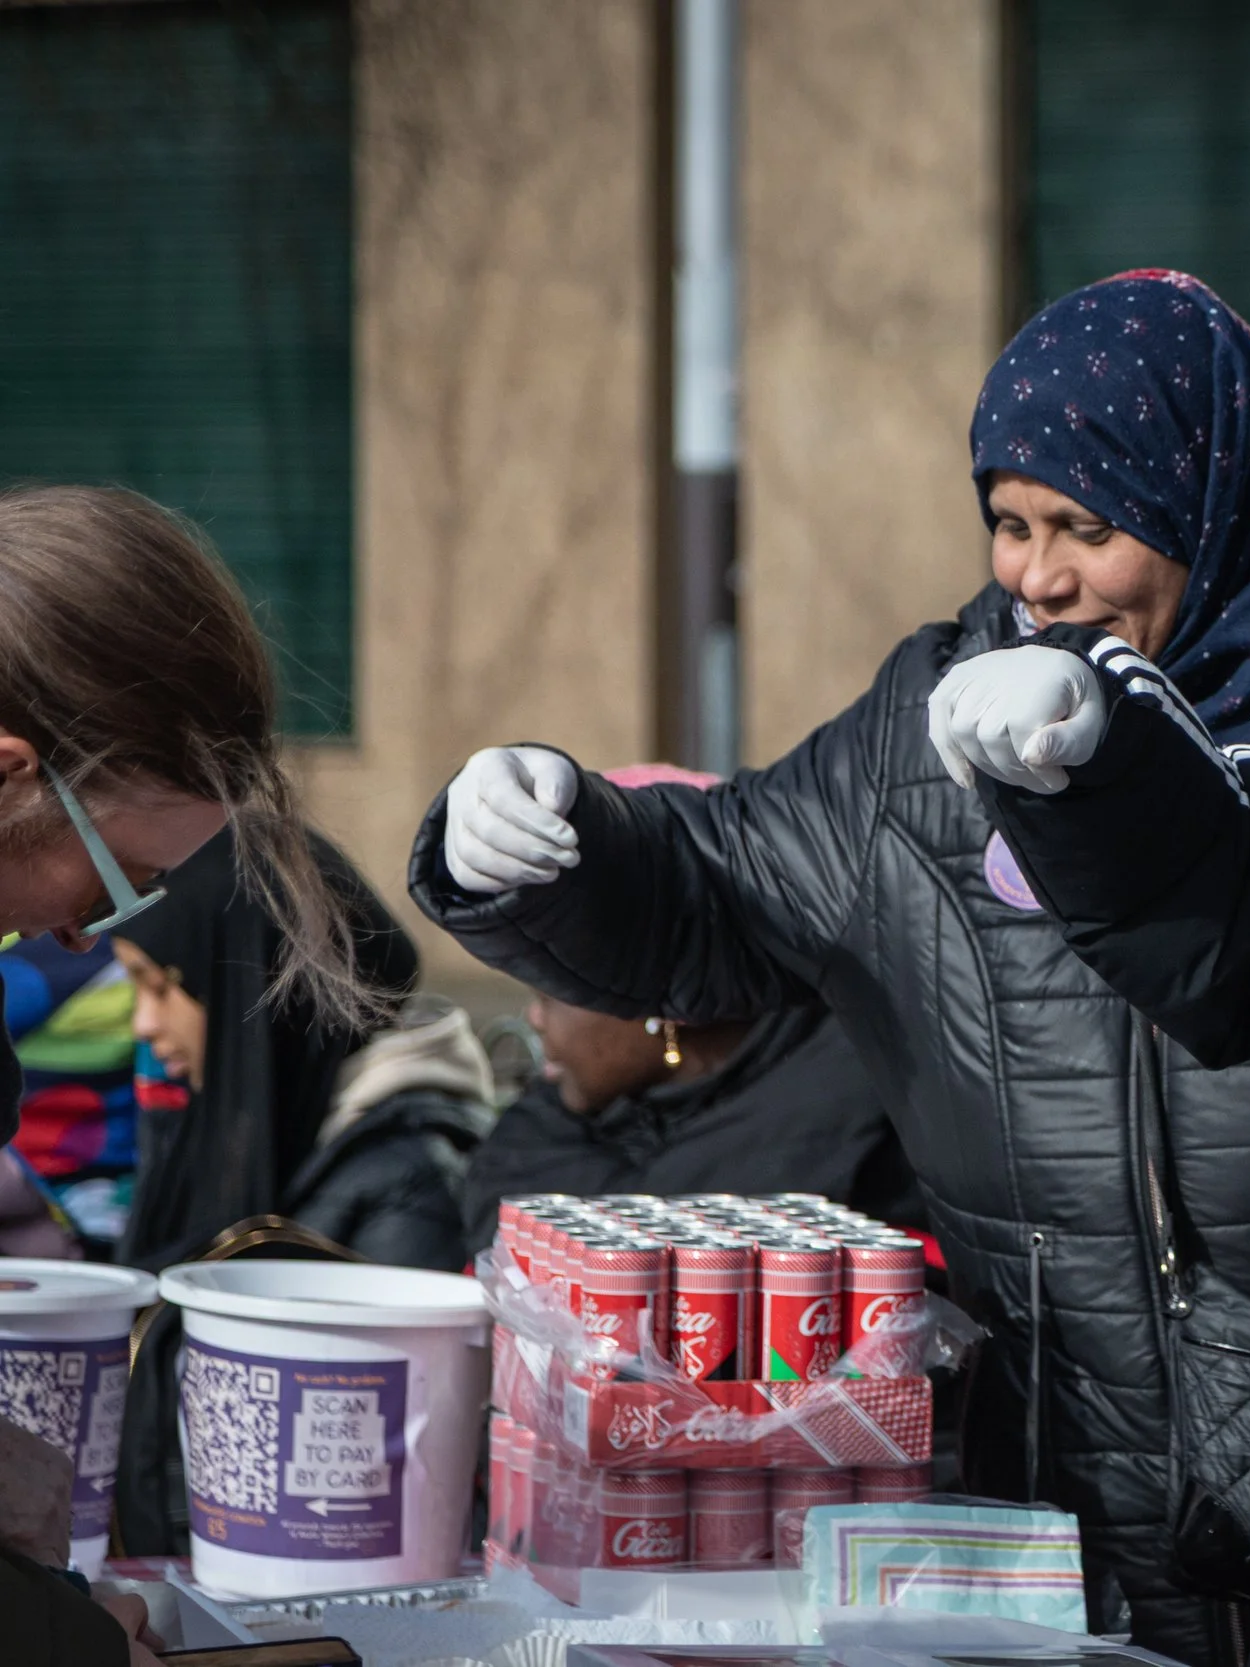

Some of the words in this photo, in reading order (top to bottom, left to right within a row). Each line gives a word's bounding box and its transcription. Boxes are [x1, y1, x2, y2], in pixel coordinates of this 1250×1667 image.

[311, 1395, 369, 1415] SCAN
[311, 1419, 362, 1440] HERE
[304, 1443, 332, 1464] TO
[339, 1444, 375, 1465] PAY
[294, 1468, 320, 1488] BY
[325, 1469, 382, 1489] CARD
